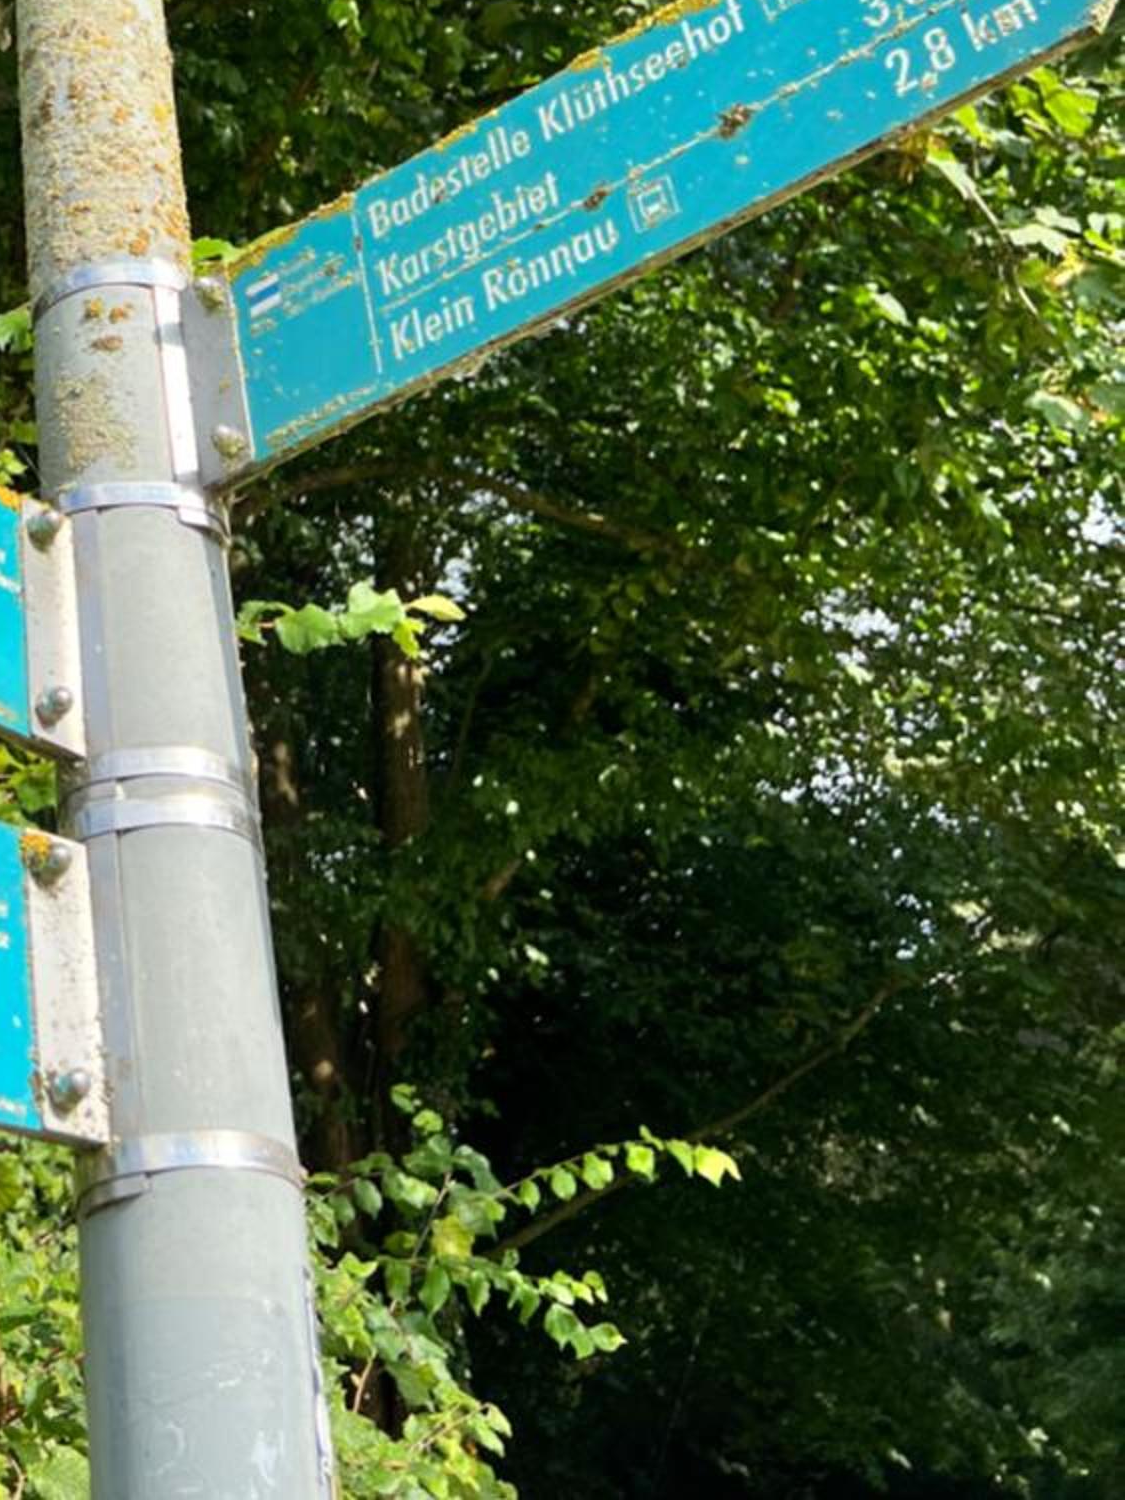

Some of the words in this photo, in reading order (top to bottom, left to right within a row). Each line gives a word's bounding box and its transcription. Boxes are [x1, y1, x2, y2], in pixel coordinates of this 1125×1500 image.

[366, 125, 531, 239] Badestelle
[375, 172, 561, 297] Karstgebiet
[388, 294, 475, 360] Klein
[480, 219, 620, 311] Rönnau
